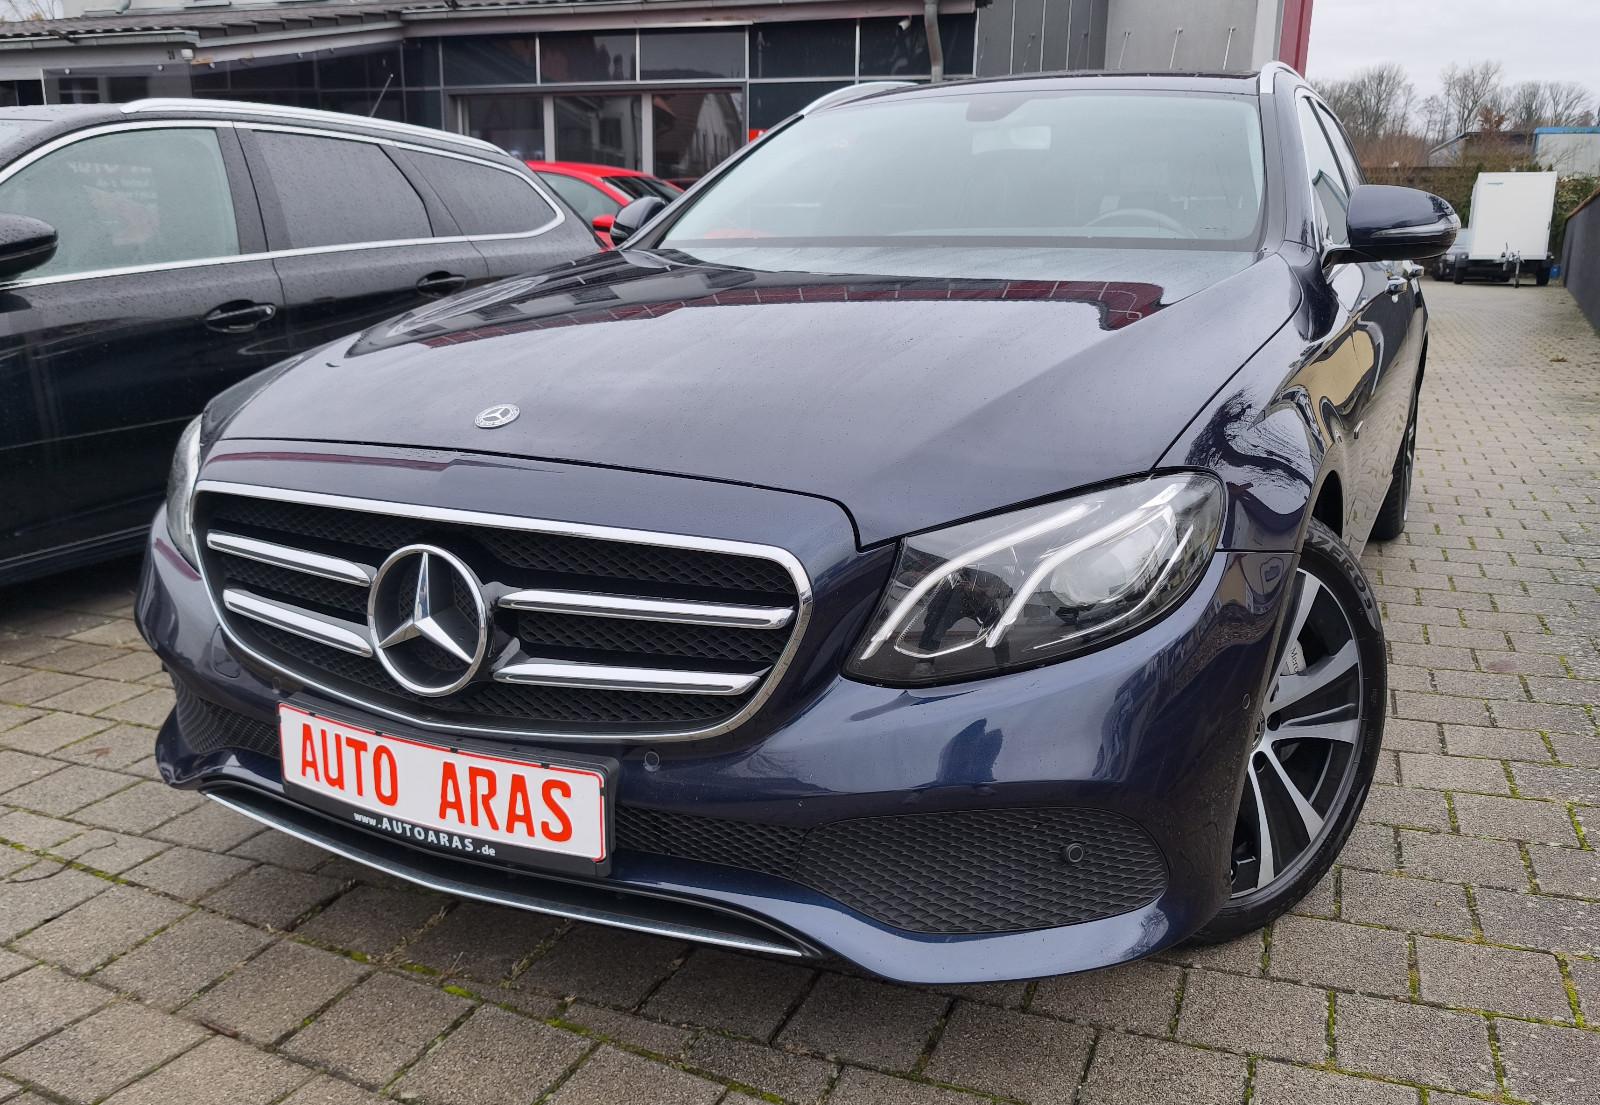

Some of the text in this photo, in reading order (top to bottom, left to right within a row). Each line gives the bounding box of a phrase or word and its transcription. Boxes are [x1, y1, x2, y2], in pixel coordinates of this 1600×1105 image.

[301, 723, 573, 842] AUTO ARAS
[354, 812, 496, 856] www.AUTOARAS.de
